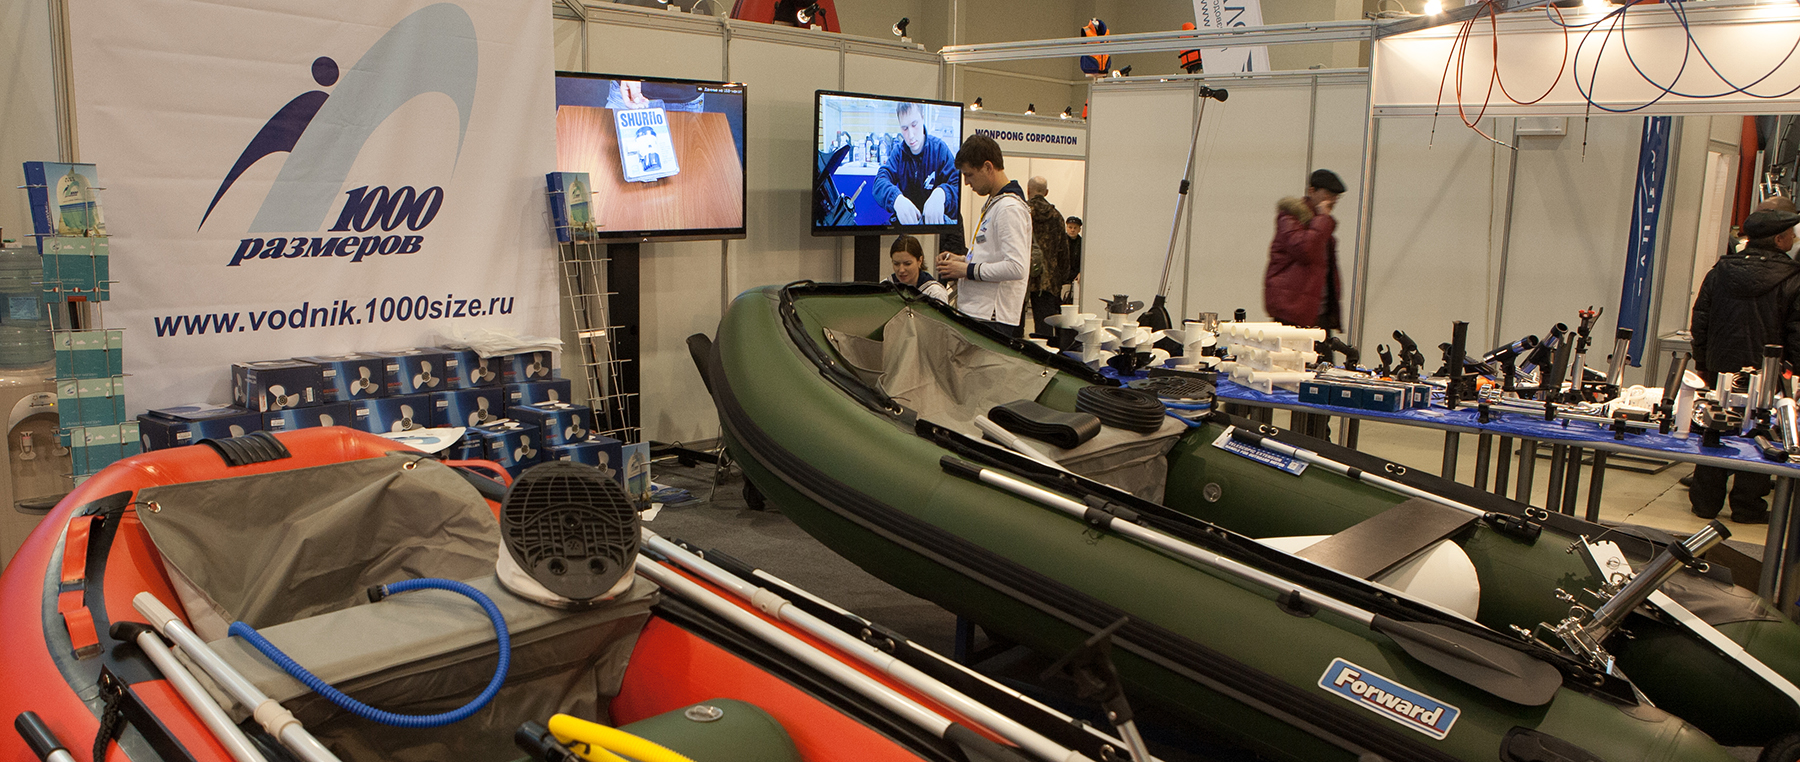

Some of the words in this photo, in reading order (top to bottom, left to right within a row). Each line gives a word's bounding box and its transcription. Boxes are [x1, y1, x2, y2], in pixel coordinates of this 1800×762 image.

[621, 111, 663, 127] SHURflo
[1025, 132, 1078, 145] CORPORATION
[327, 185, 444, 233] 1000
[226, 234, 425, 267] размеров
[154, 293, 515, 338] www.vodnik.1000size.ru
[1334, 667, 1445, 726] Forward
